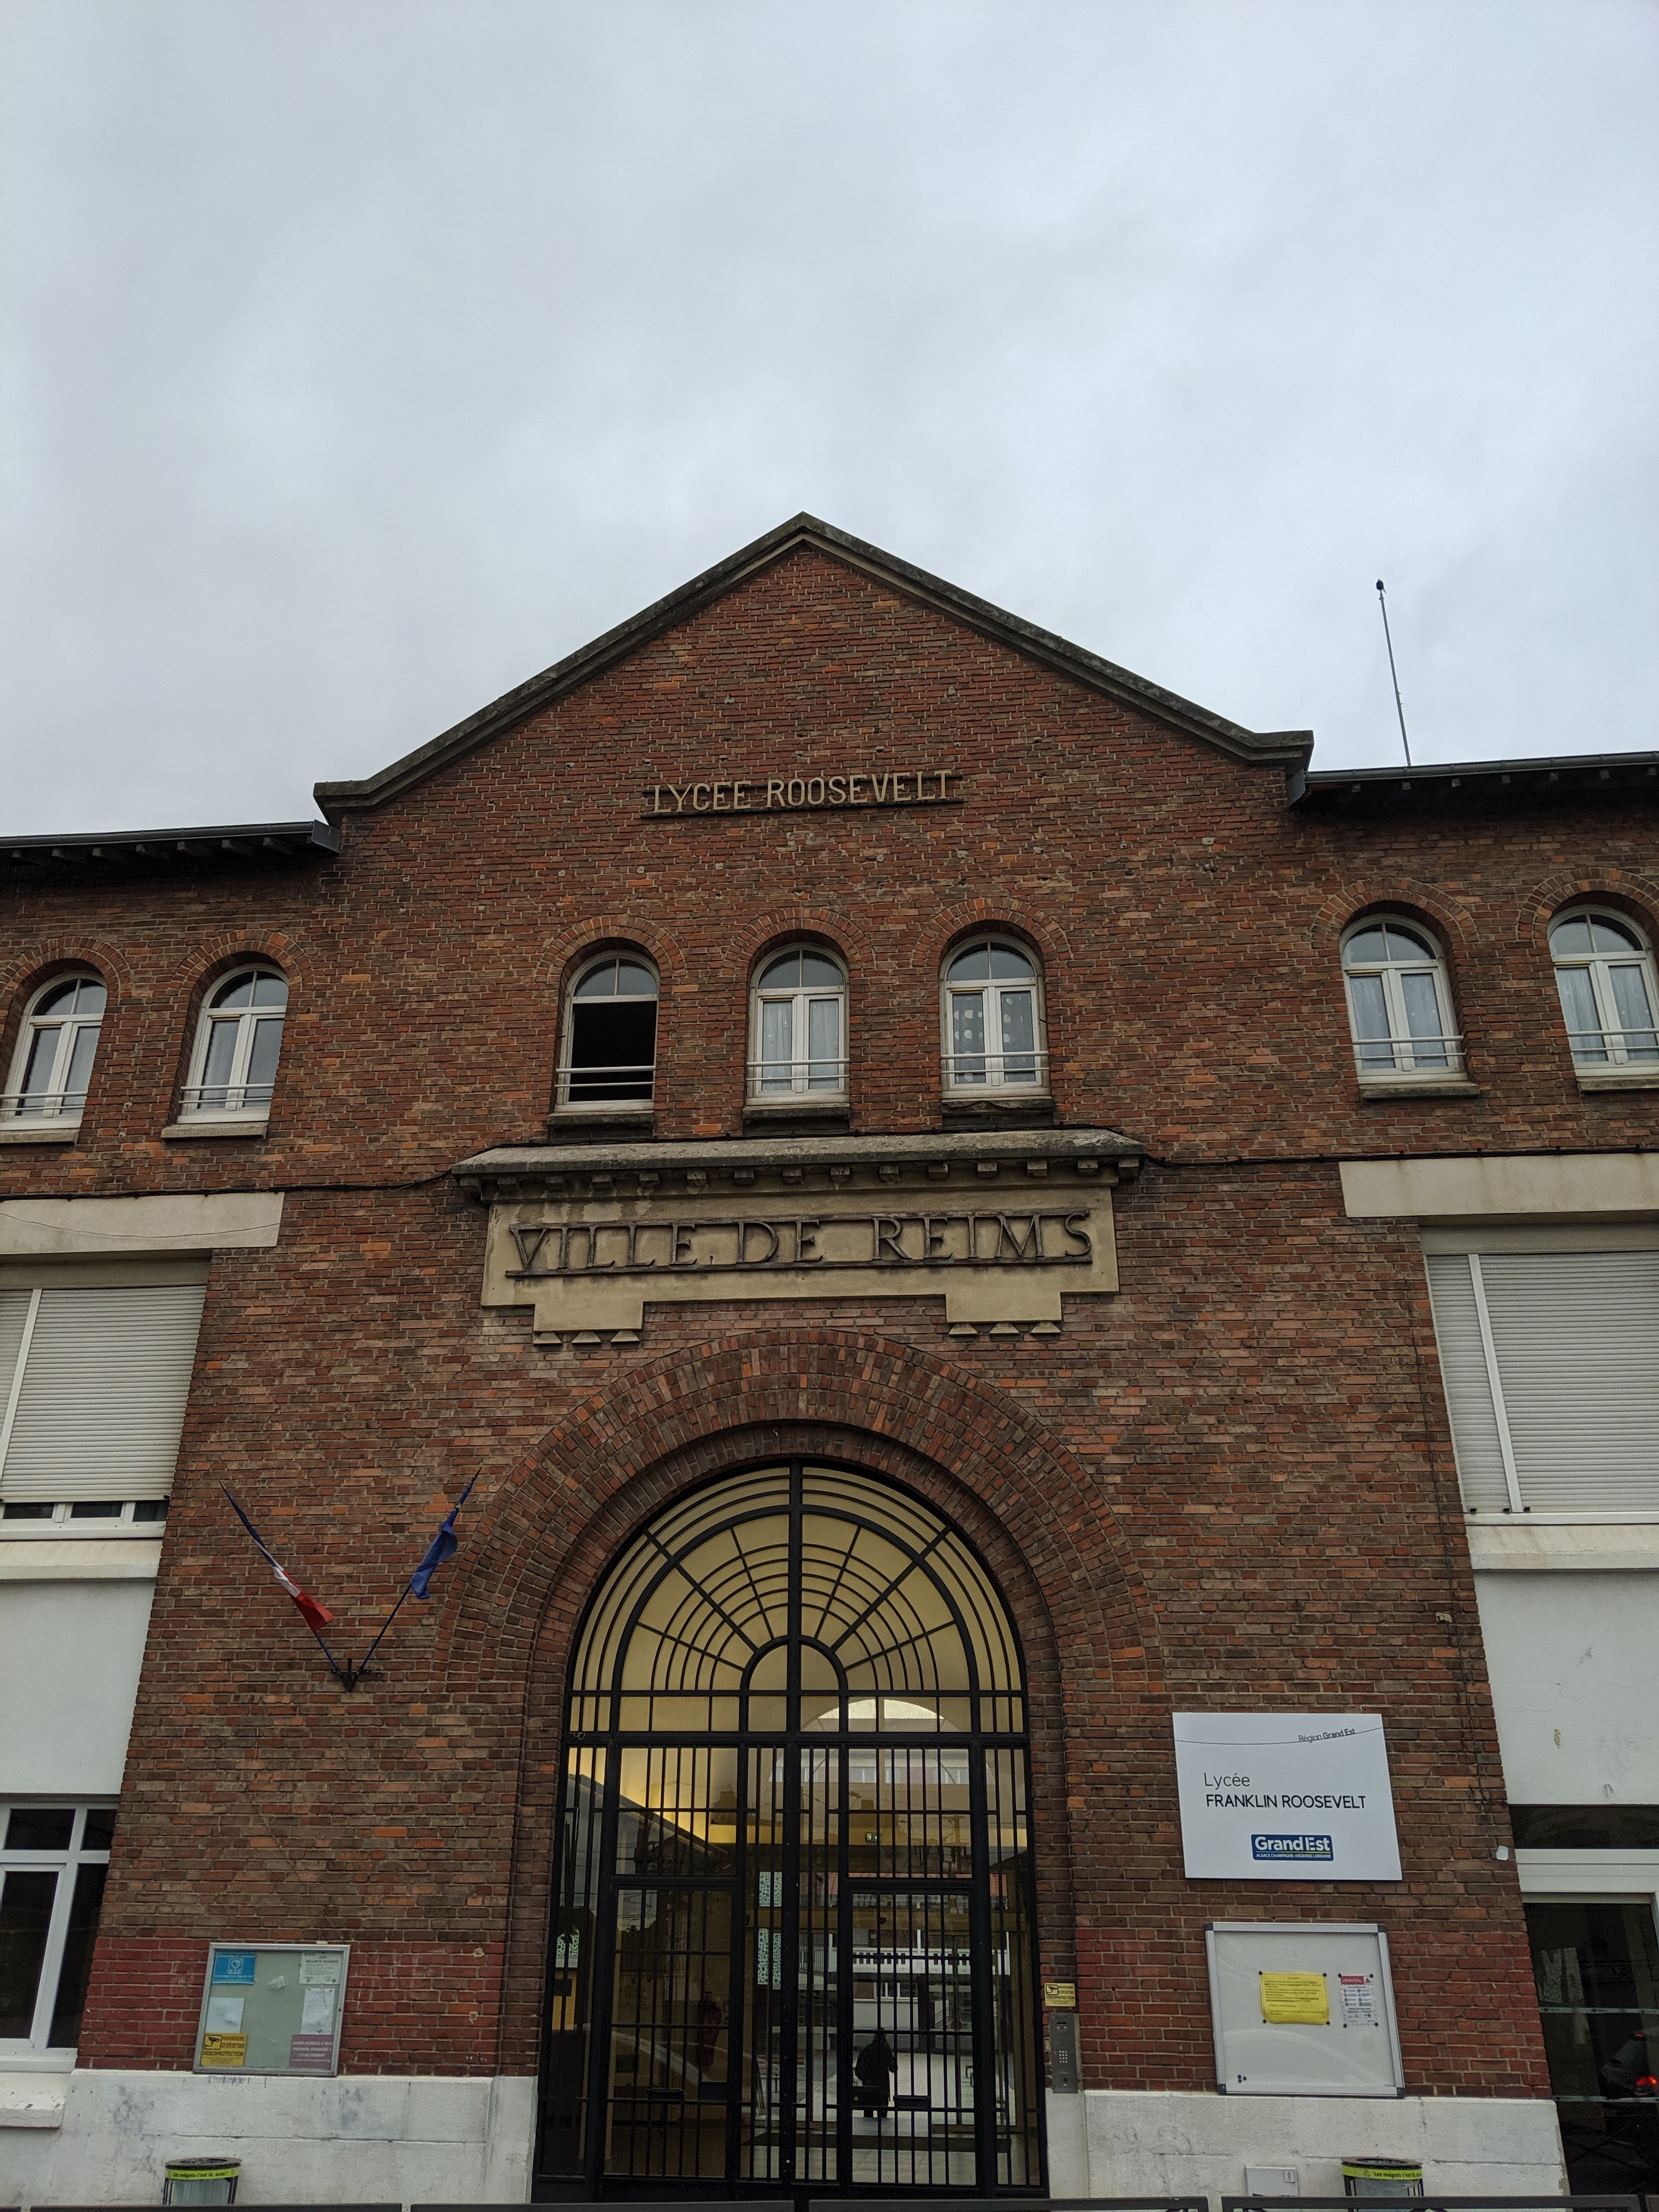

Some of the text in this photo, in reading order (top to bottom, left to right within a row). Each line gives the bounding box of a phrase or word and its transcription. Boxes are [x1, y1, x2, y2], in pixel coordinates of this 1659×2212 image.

[765, 770, 952, 808] ROOSEVELT
[509, 1214, 1092, 1269] VILLE DE REIMS
[1298, 1734, 1322, 1743] Région
[1323, 1730, 1344, 1739] Grand
[1204, 1772, 1250, 1790] Lycée
[1206, 1794, 1366, 1809] FRANKLIN ROOSEVELT
